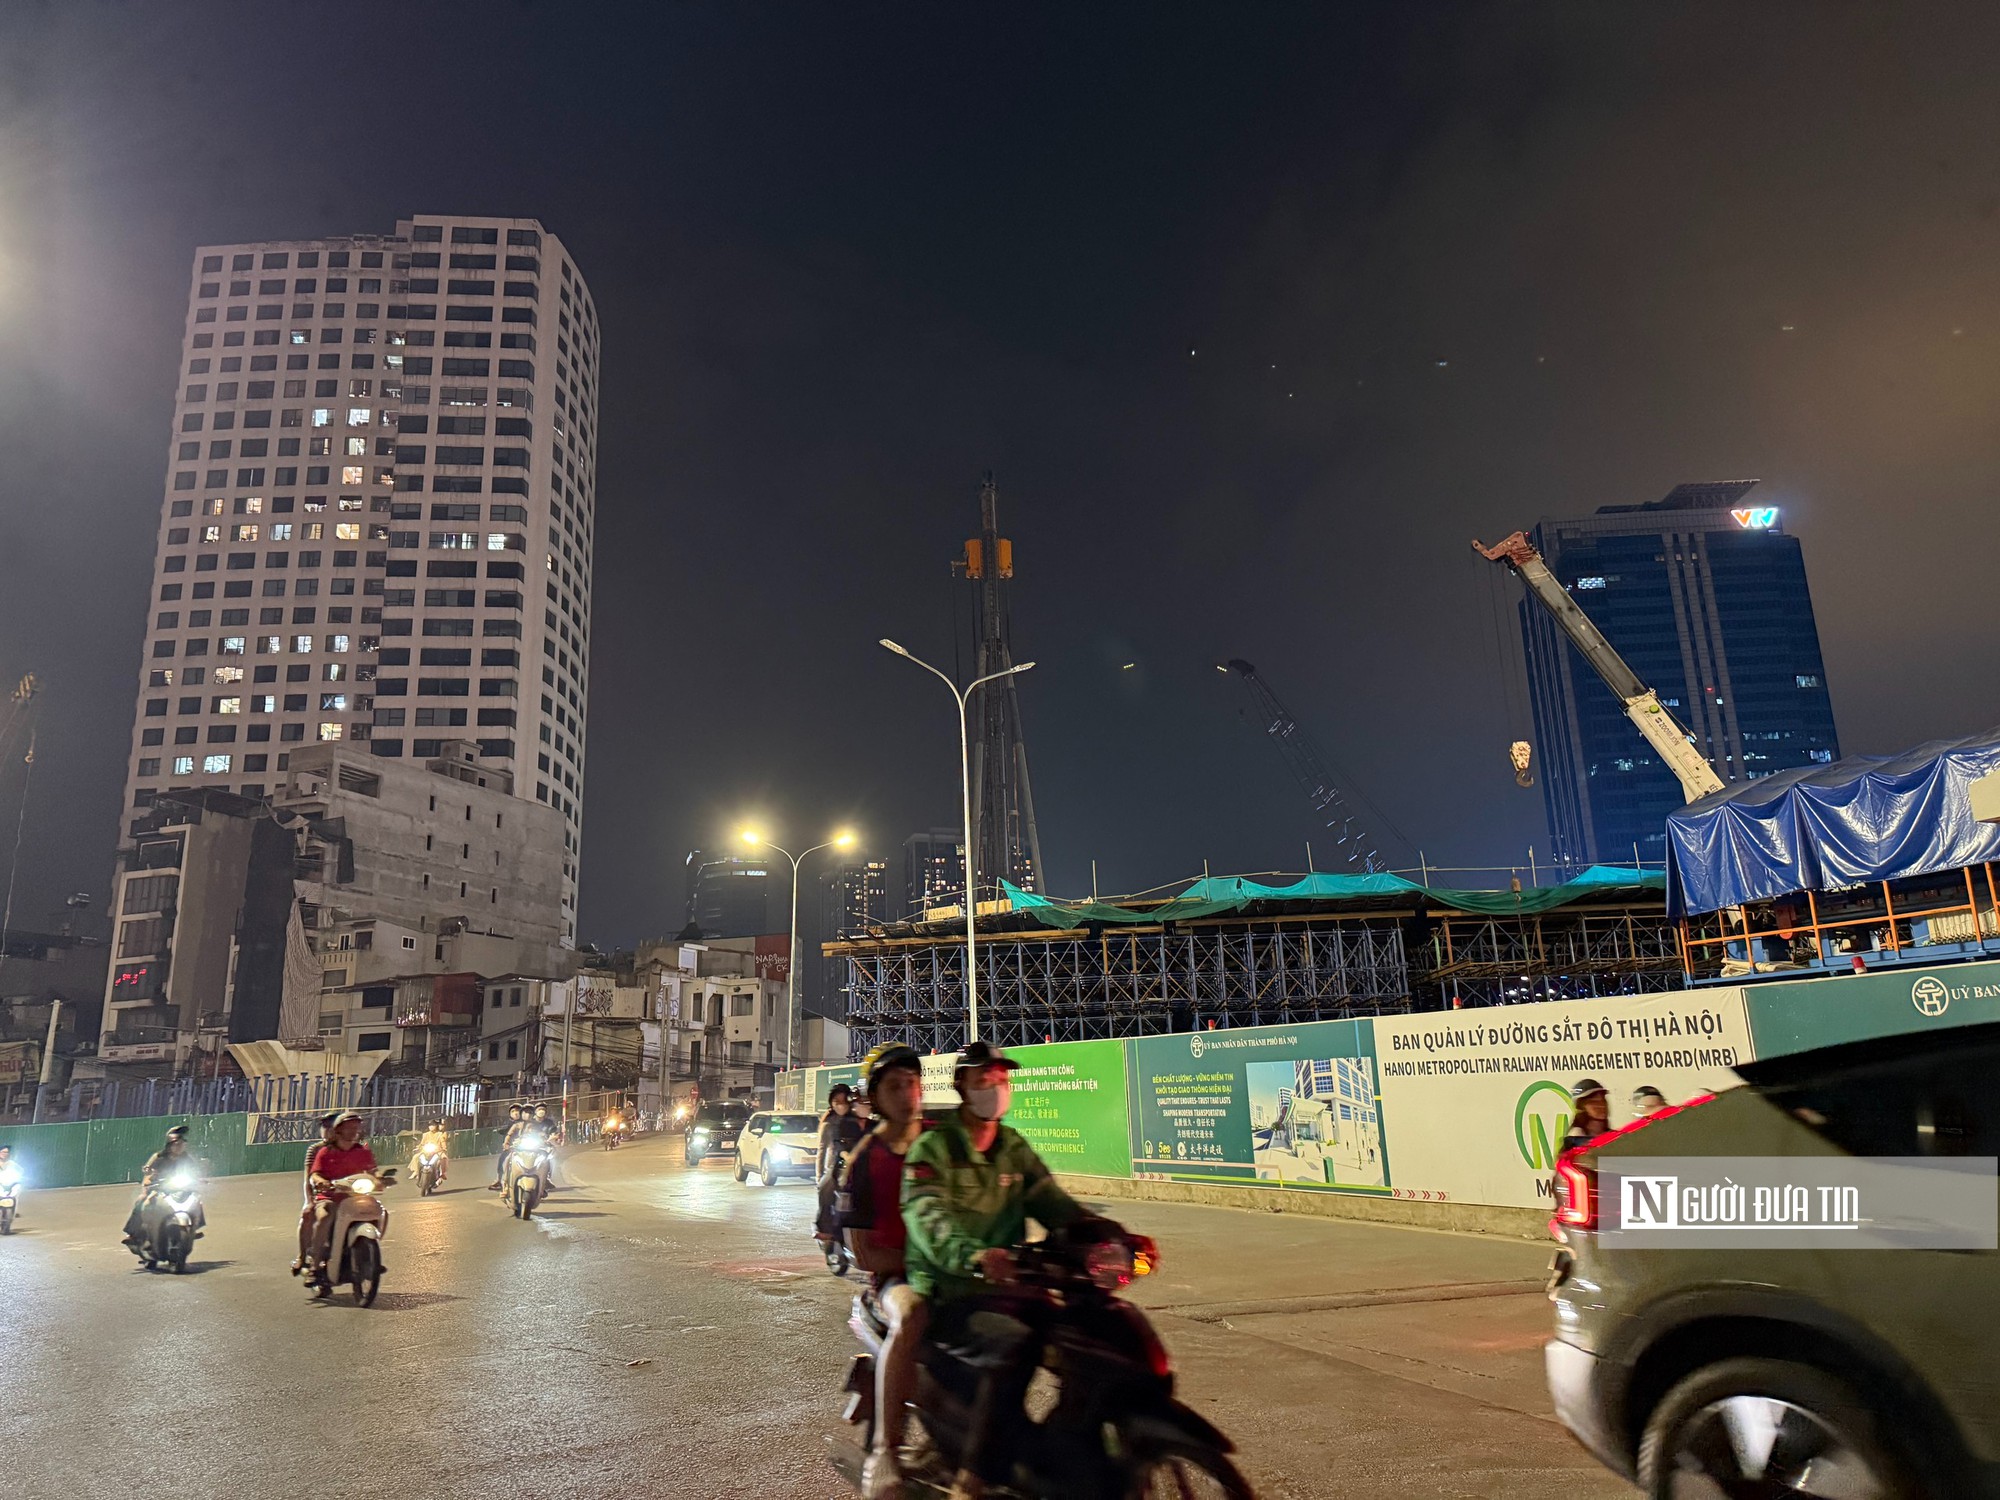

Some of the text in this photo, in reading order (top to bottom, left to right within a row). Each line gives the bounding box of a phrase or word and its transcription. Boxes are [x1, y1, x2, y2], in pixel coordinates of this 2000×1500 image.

[1730, 508, 1778, 528] VTV
[1951, 984, 1970, 1000] UỶ
[1392, 1009, 1723, 1053] BAN QUẢN LÝ ĐƯỜNG SẮT ĐÔ THỊ HÀ NỘI
[1047, 1066, 1057, 1075] THI
[1058, 1064, 1075, 1075] CÔNG
[1384, 1061, 1416, 1076] HANOI
[1417, 1058, 1500, 1075] METROPOLITAN
[1503, 1056, 1549, 1072] RALWAY
[1551, 1051, 1641, 1071] MANAGEMENT
[1050, 1079, 1071, 1090] THÔNG
[1084, 1078, 1098, 1092] TIỆN
[1048, 1128, 1080, 1138] PROGRESS
